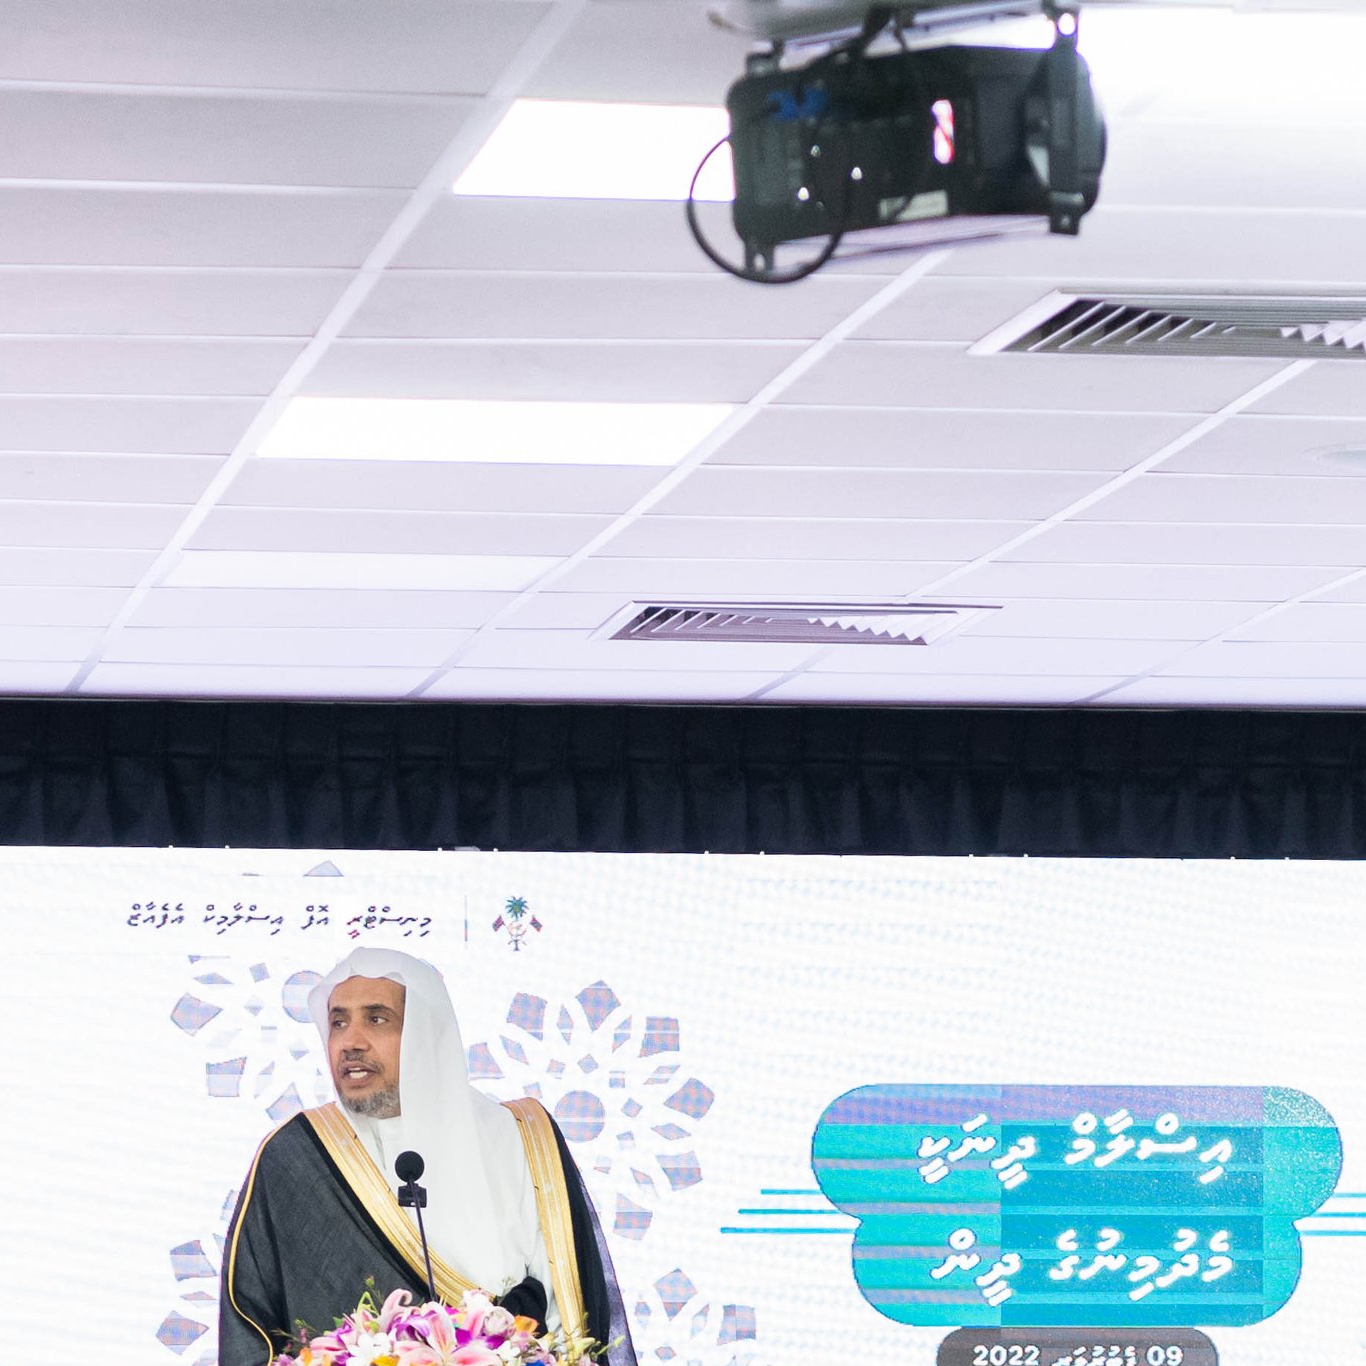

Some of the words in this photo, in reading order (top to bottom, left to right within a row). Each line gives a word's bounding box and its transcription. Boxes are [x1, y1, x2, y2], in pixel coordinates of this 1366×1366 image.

[916, 1113, 1037, 1190] ދީނަކީ
[1064, 1108, 1233, 1185] އިސްލާމް
[929, 1227, 1022, 1307] ދީން
[972, 1344, 1041, 1366] 2022
